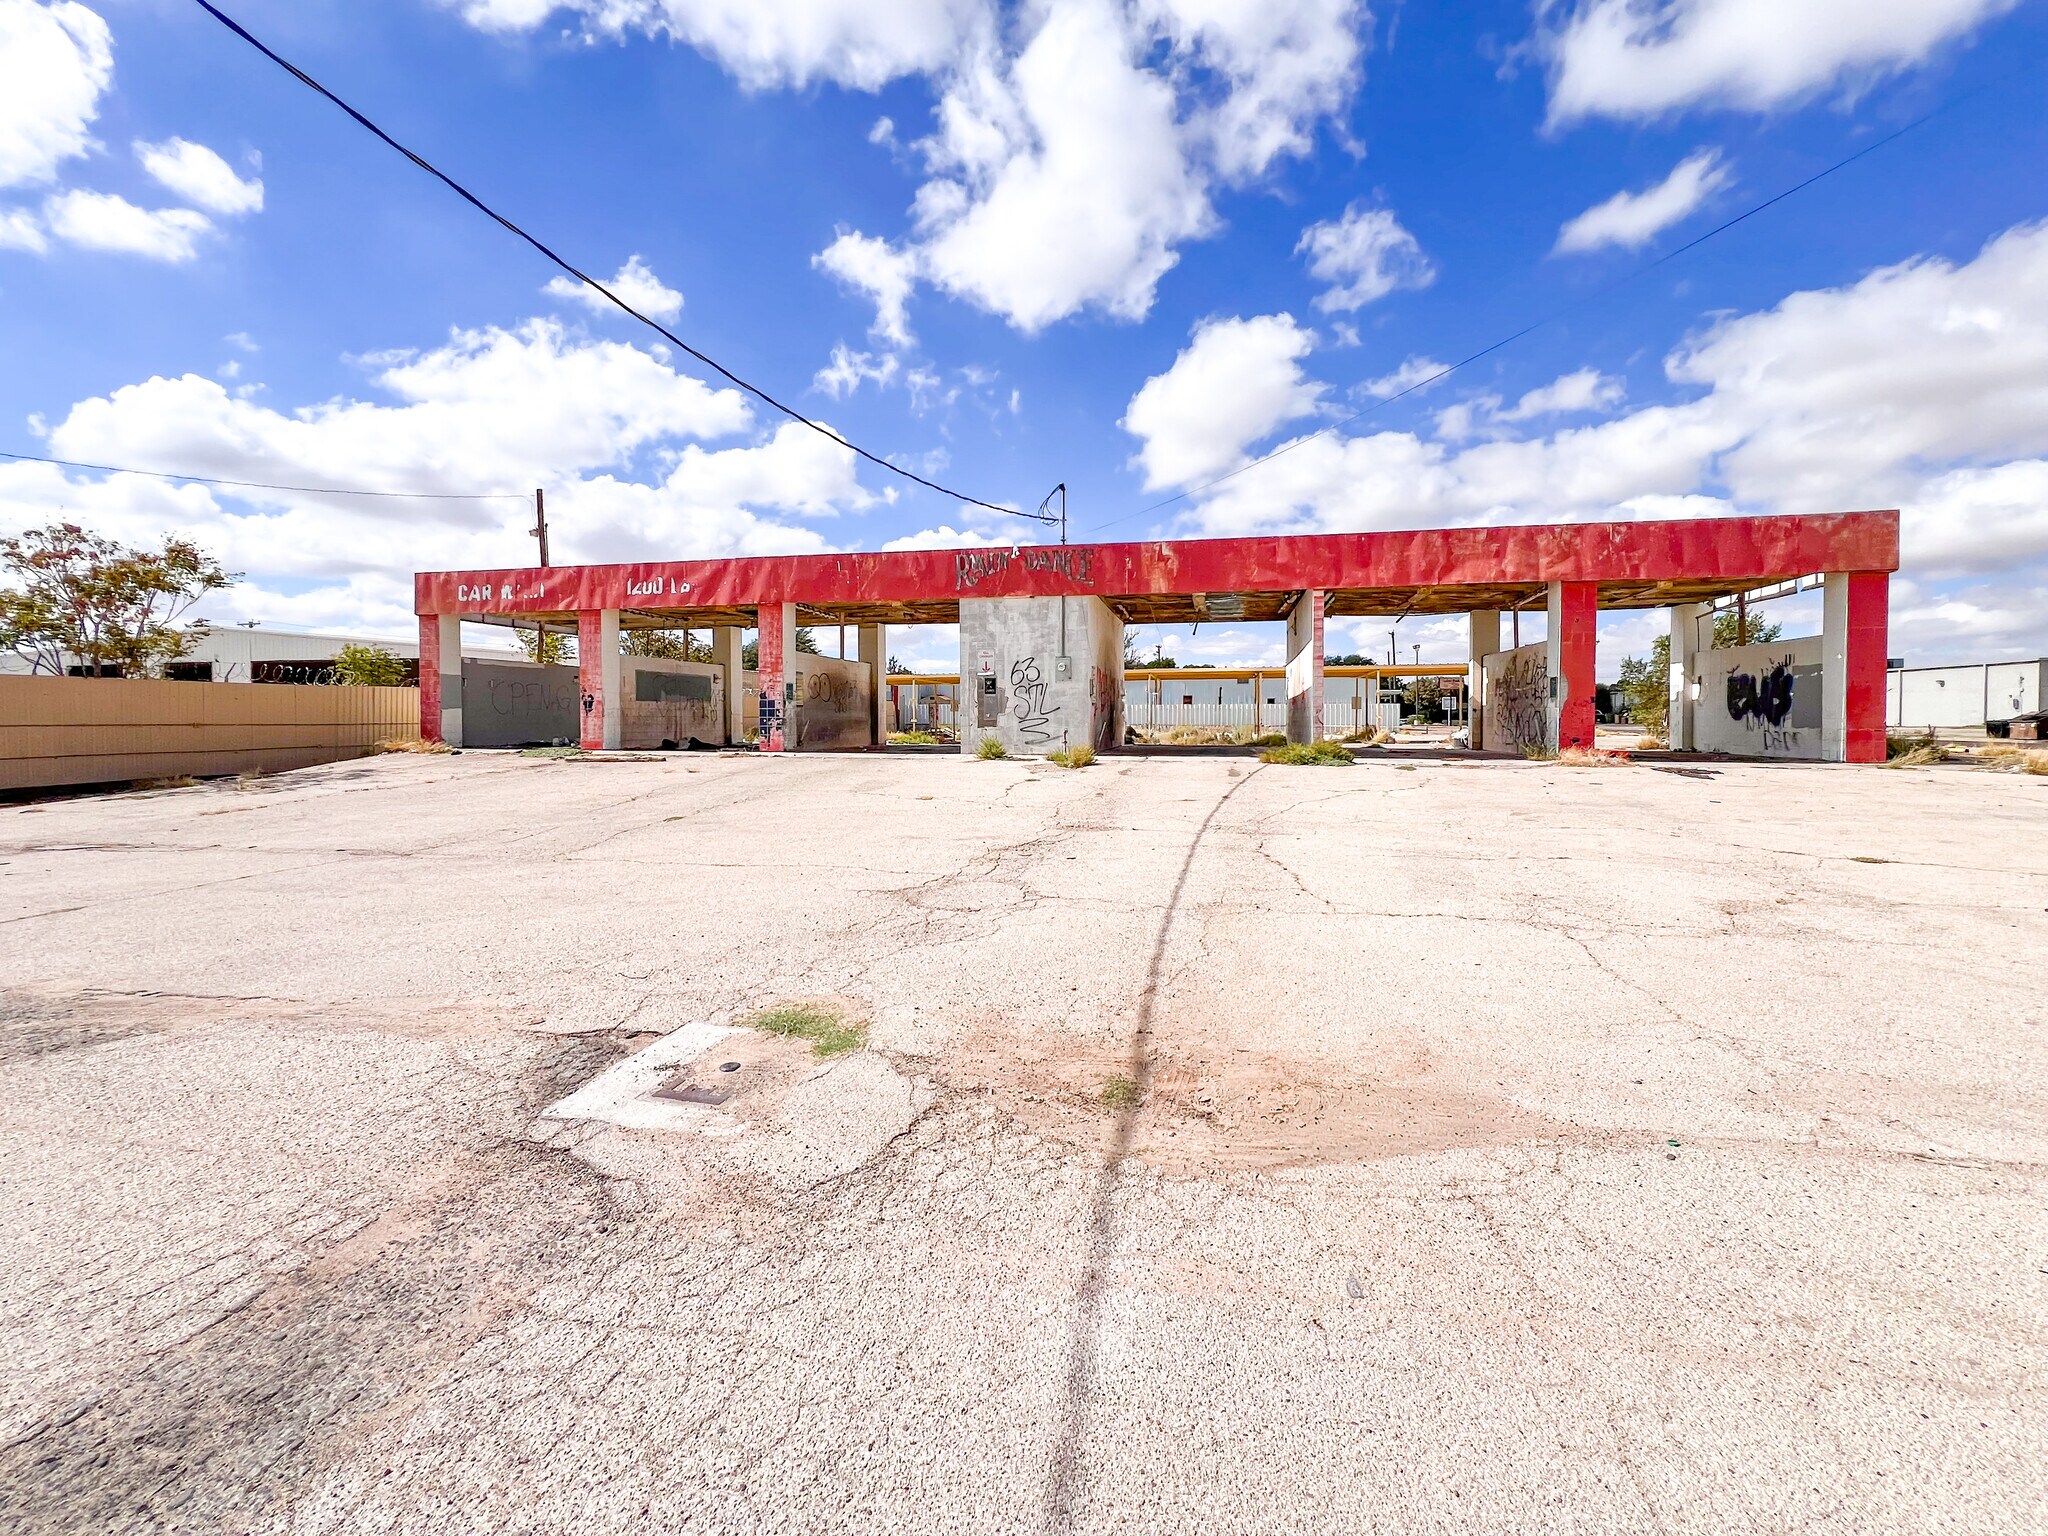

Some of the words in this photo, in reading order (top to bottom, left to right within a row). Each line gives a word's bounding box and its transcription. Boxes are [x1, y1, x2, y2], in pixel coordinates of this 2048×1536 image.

[955, 552, 1010, 590] RAIN
[1024, 549, 1094, 587] DANCE
[458, 584, 492, 601] CAR
[1010, 656, 1040, 686] 63
[1013, 682, 1060, 720] STL
